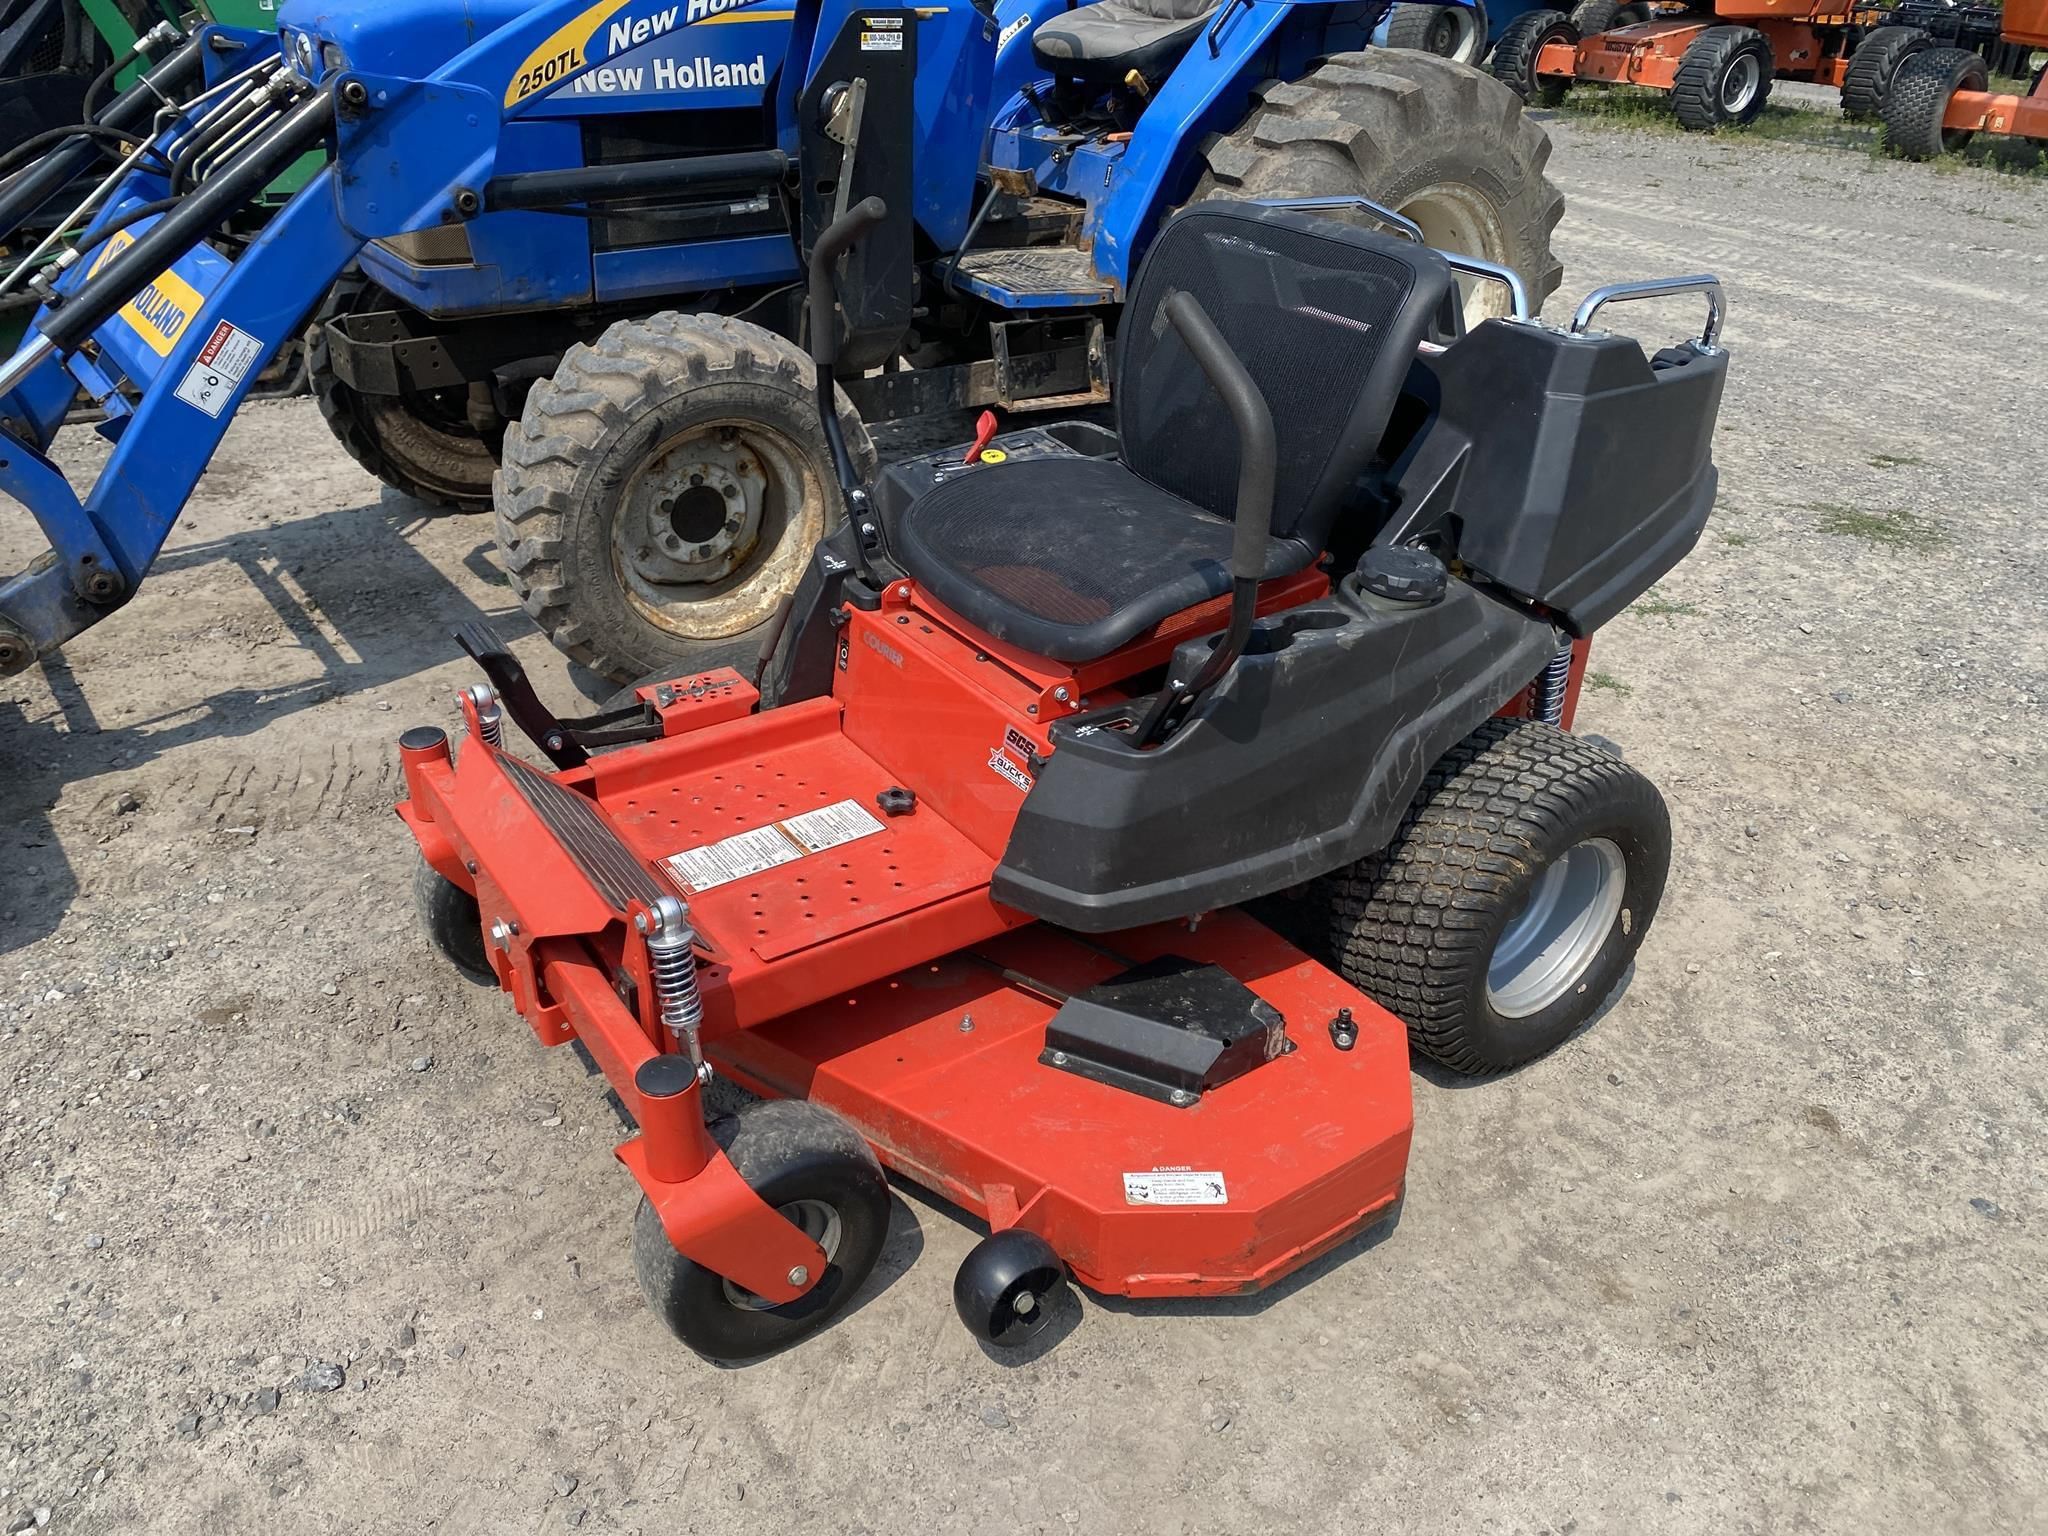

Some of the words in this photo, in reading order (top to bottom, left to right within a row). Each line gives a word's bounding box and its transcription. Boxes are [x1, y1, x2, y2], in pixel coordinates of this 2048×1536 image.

[608, 6, 678, 56] New
[517, 48, 581, 98] 250TL
[573, 67, 643, 93] New
[653, 55, 766, 90] Holland
[131, 284, 186, 339] OLLAND
[207, 325, 230, 354] DANGER
[996, 757, 1031, 786] BUCK'S
